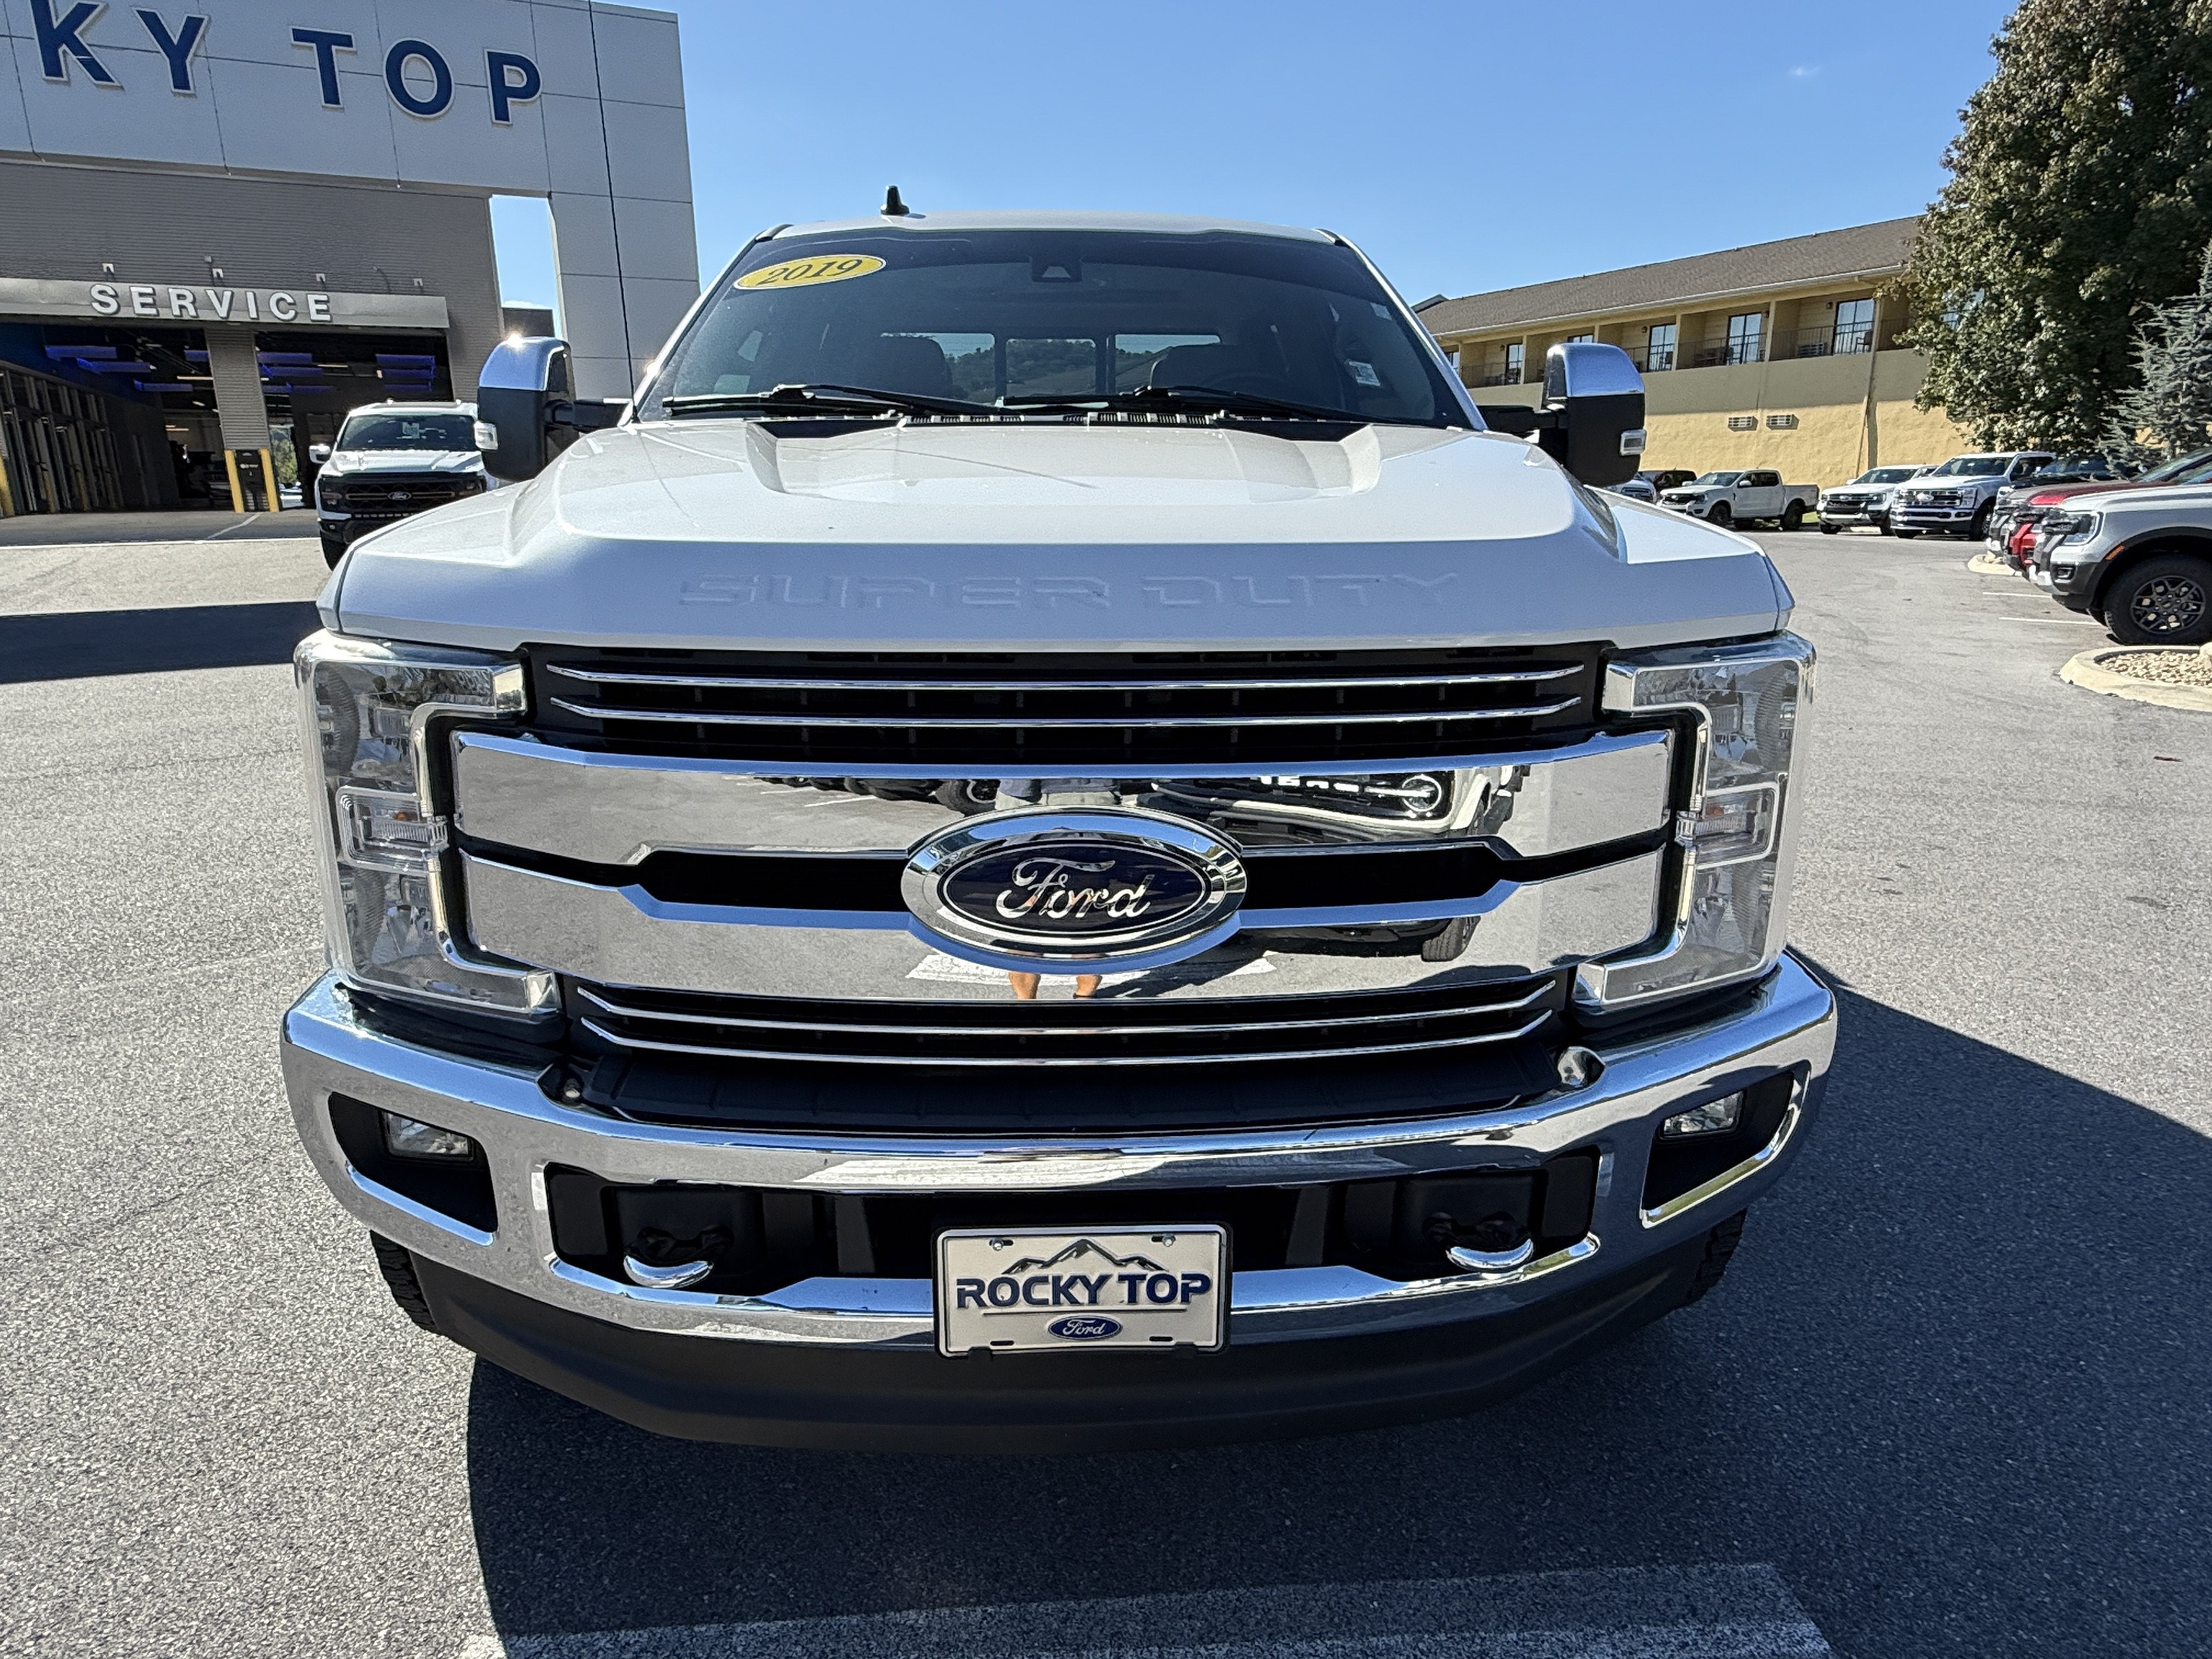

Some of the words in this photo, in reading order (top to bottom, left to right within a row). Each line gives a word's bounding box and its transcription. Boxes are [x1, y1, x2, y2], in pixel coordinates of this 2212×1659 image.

[290, 26, 543, 125] TOP
[755, 259, 863, 286] 2019
[91, 284, 331, 323] SERVICE
[679, 574, 1113, 608] SUPER
[1141, 573, 1459, 607] DUTY
[996, 857, 1155, 919] Ford
[956, 1273, 1113, 1308] ROCKY
[1118, 1273, 1211, 1304] TOP
[1062, 1318, 1105, 1336] Ford
